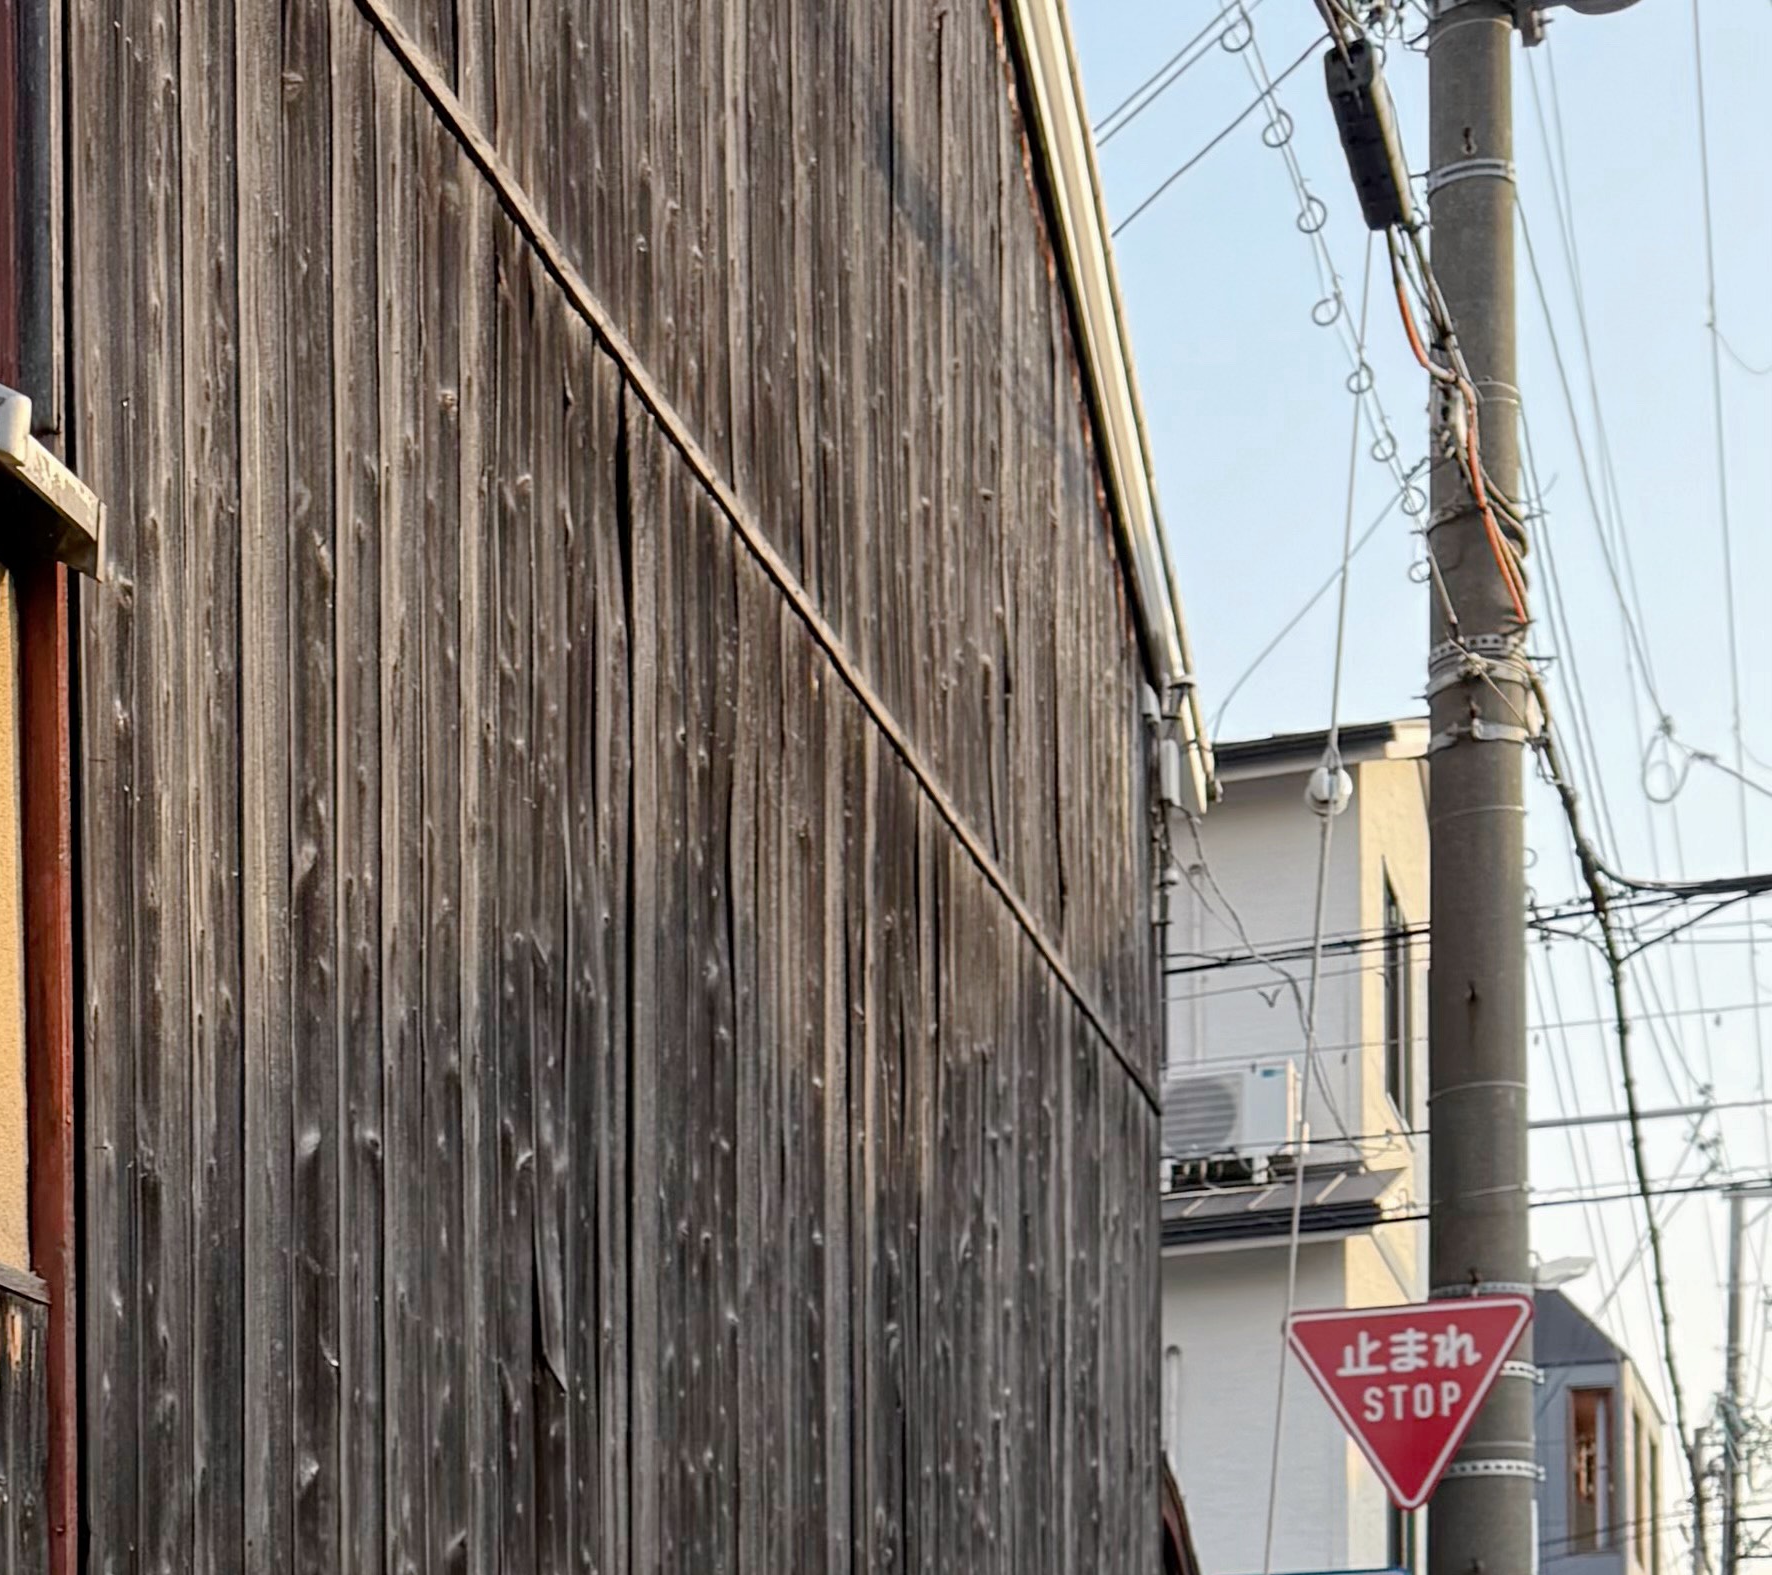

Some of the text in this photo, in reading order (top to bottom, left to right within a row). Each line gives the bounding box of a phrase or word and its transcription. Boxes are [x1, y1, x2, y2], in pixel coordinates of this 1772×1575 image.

[1335, 1323, 1482, 1377] 止まれ
[1362, 1380, 1462, 1422] STOP
